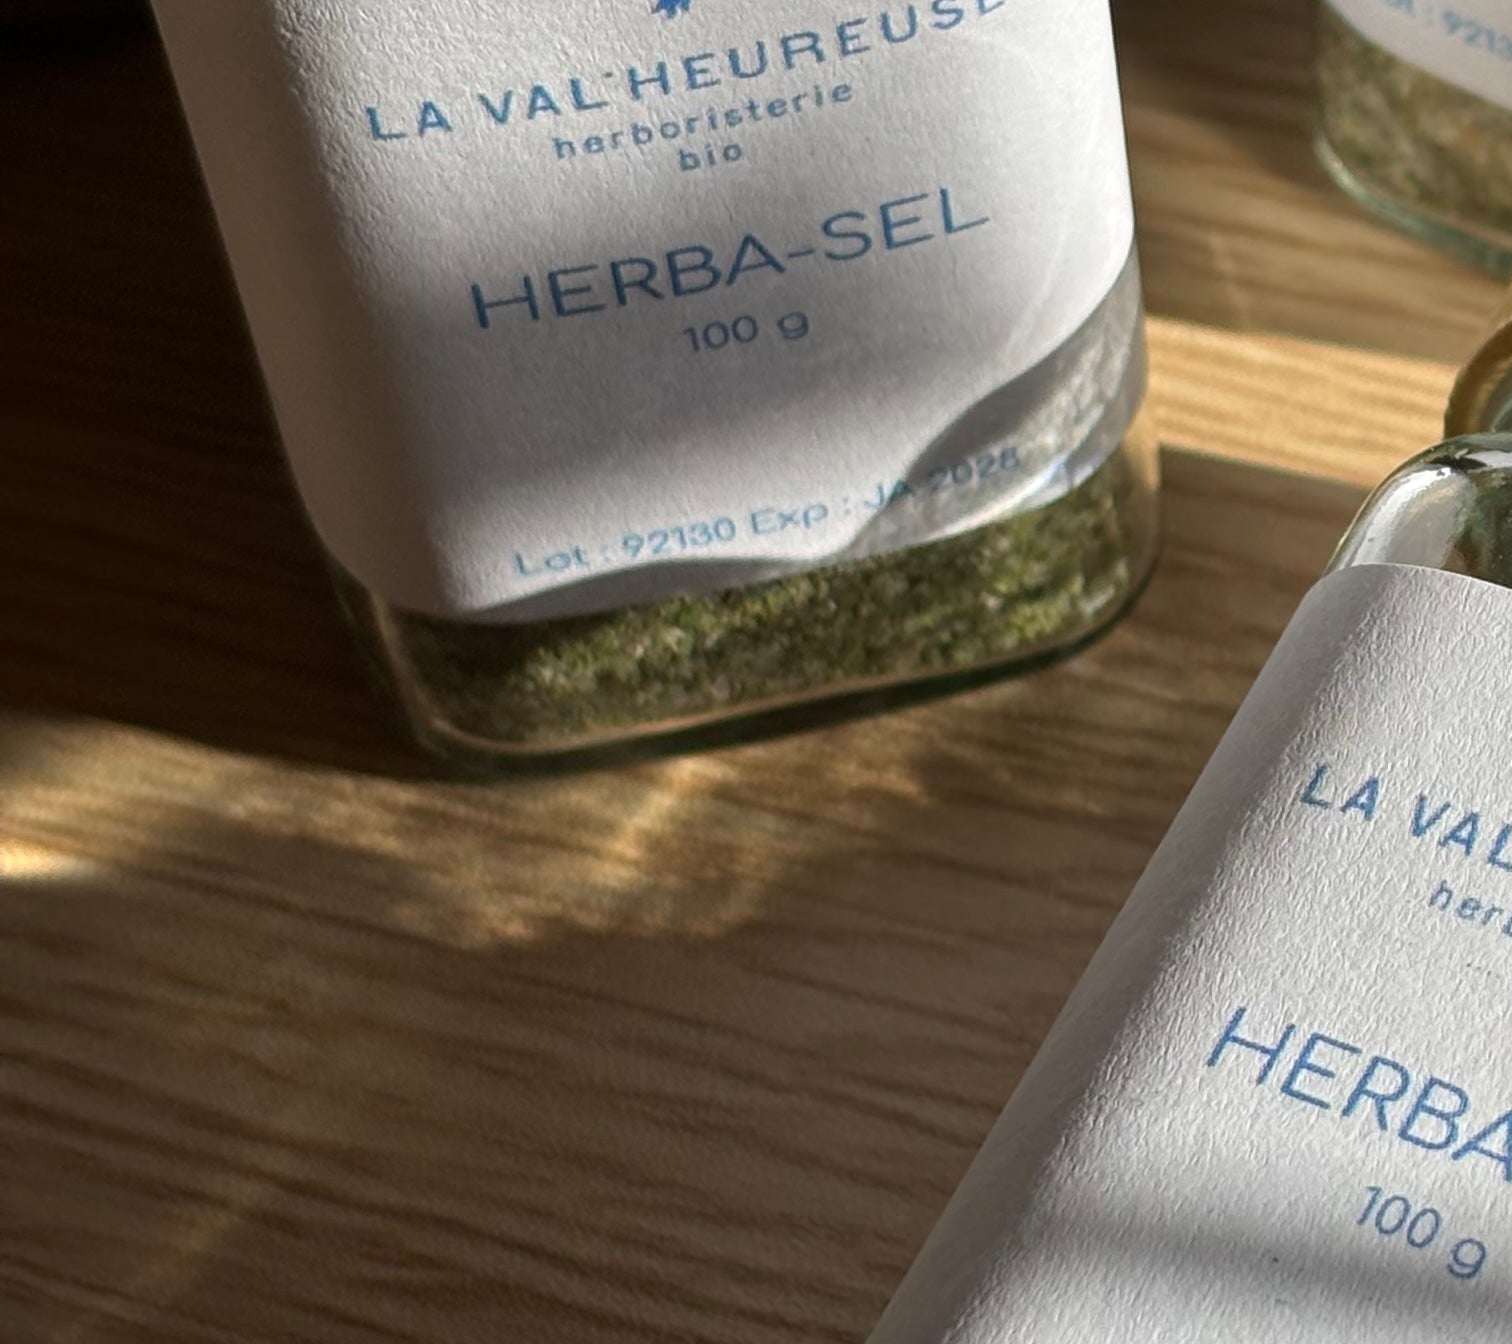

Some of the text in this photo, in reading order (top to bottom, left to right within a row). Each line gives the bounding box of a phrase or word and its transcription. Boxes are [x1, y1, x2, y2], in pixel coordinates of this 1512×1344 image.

[366, 101, 453, 142] LA
[552, 80, 855, 160] herboristerie
[677, 139, 744, 172] bio
[470, 186, 990, 329] HERBA-SEL
[684, 312, 811, 355] 100 g
[621, 517, 737, 559] 92130
[1300, 764, 1379, 823] LA
[1357, 1186, 1486, 1280] 100 g
